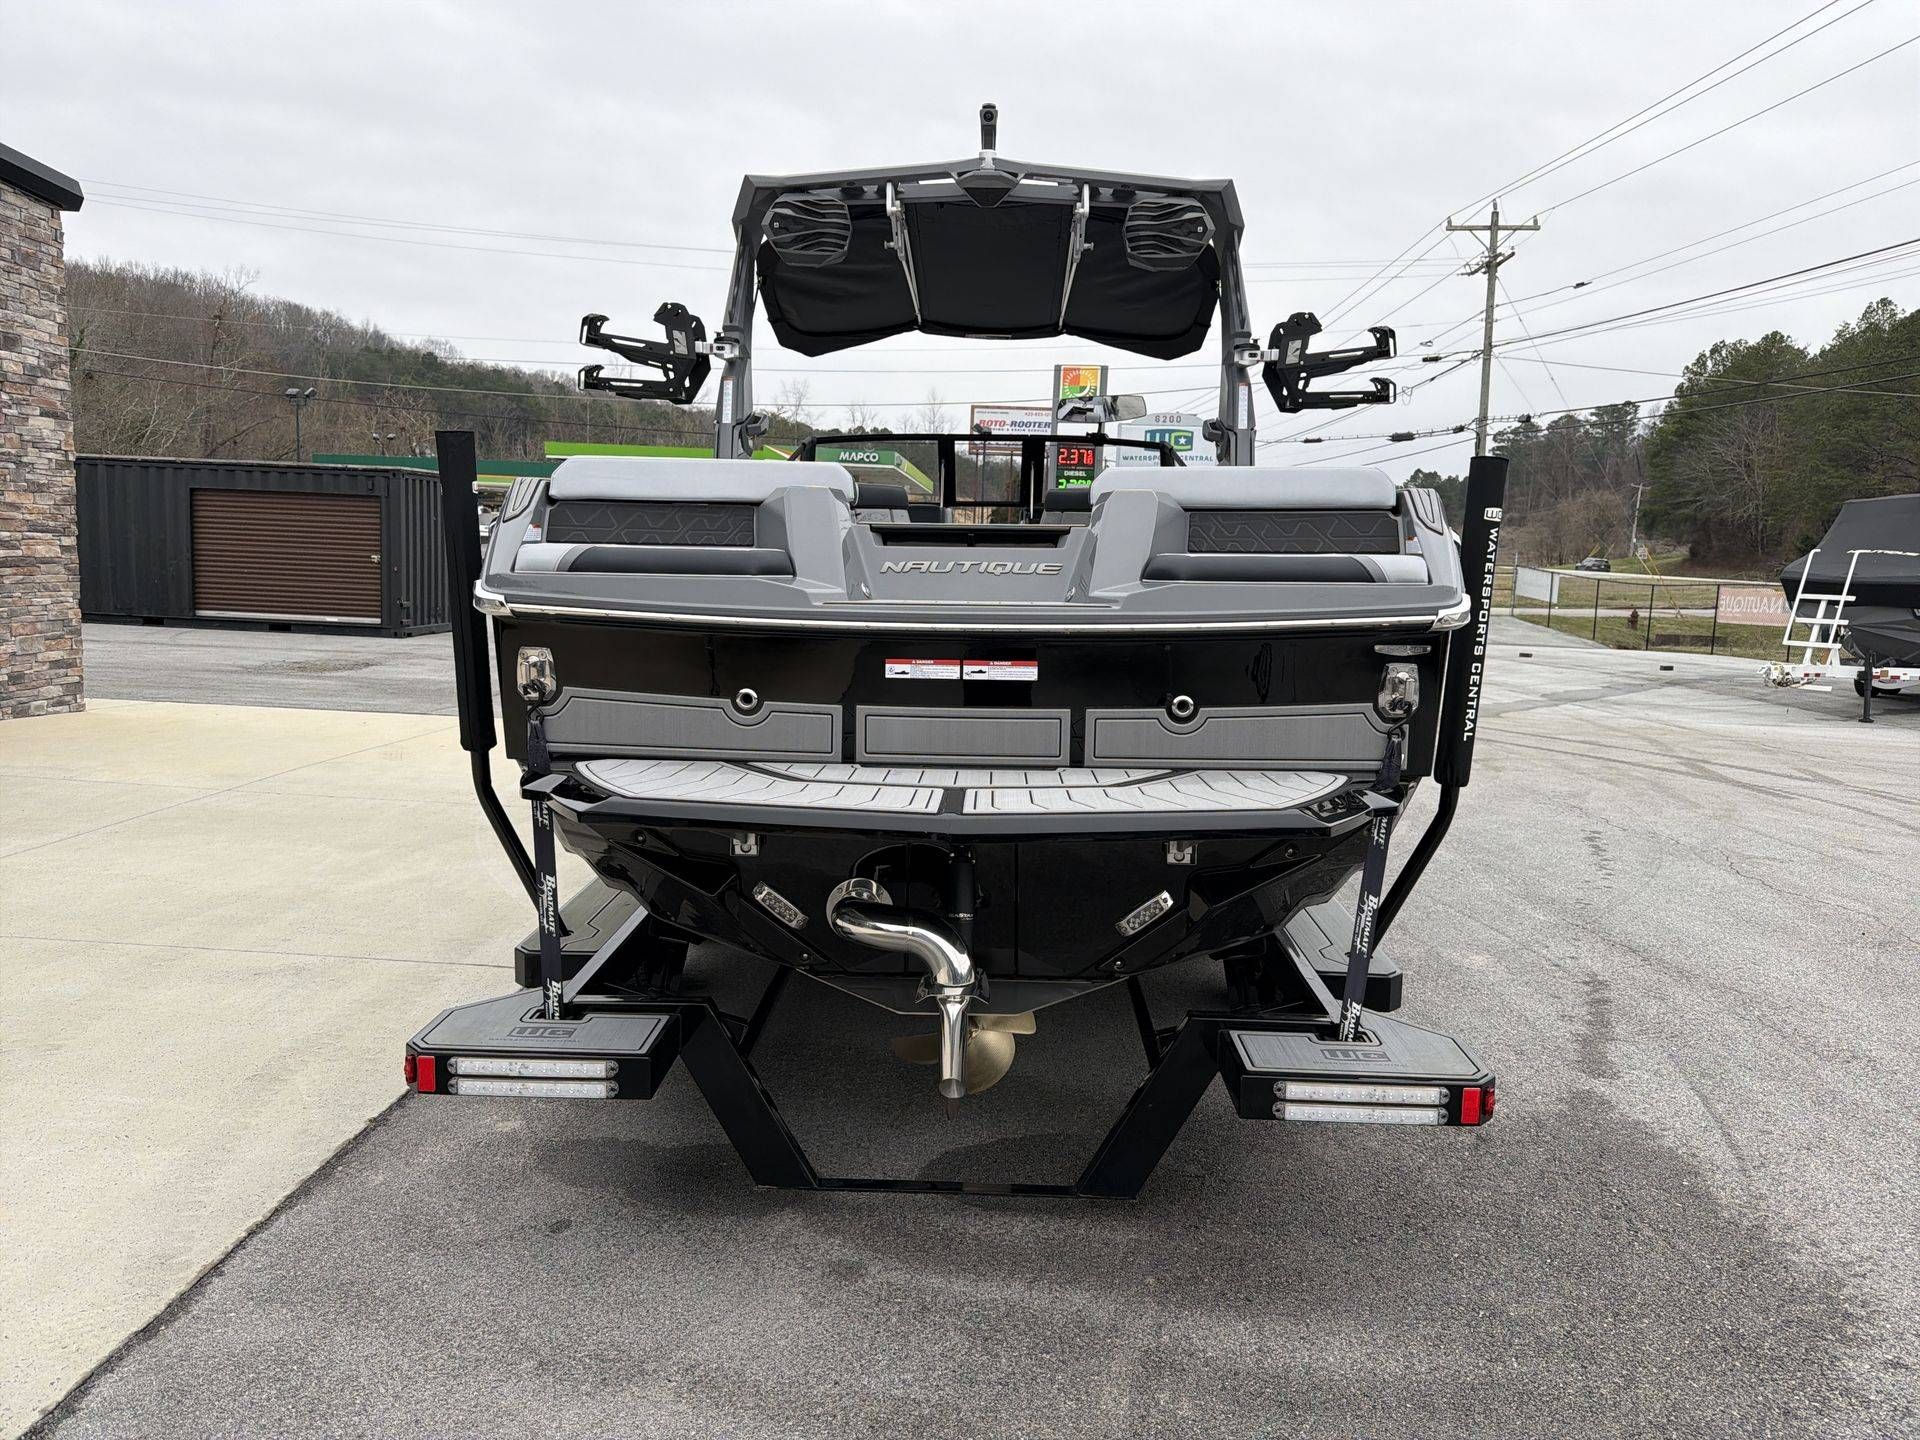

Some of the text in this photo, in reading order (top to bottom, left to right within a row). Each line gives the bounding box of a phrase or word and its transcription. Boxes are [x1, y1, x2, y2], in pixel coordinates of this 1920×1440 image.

[979, 420, 1051, 429] ROTO-ROOTER
[1155, 415, 1182, 423] 6200
[839, 451, 879, 462] MAPCO
[880, 561, 1063, 576] NAUTIQUE
[1463, 527, 1499, 742] WATERSPORTS CENTRAL
